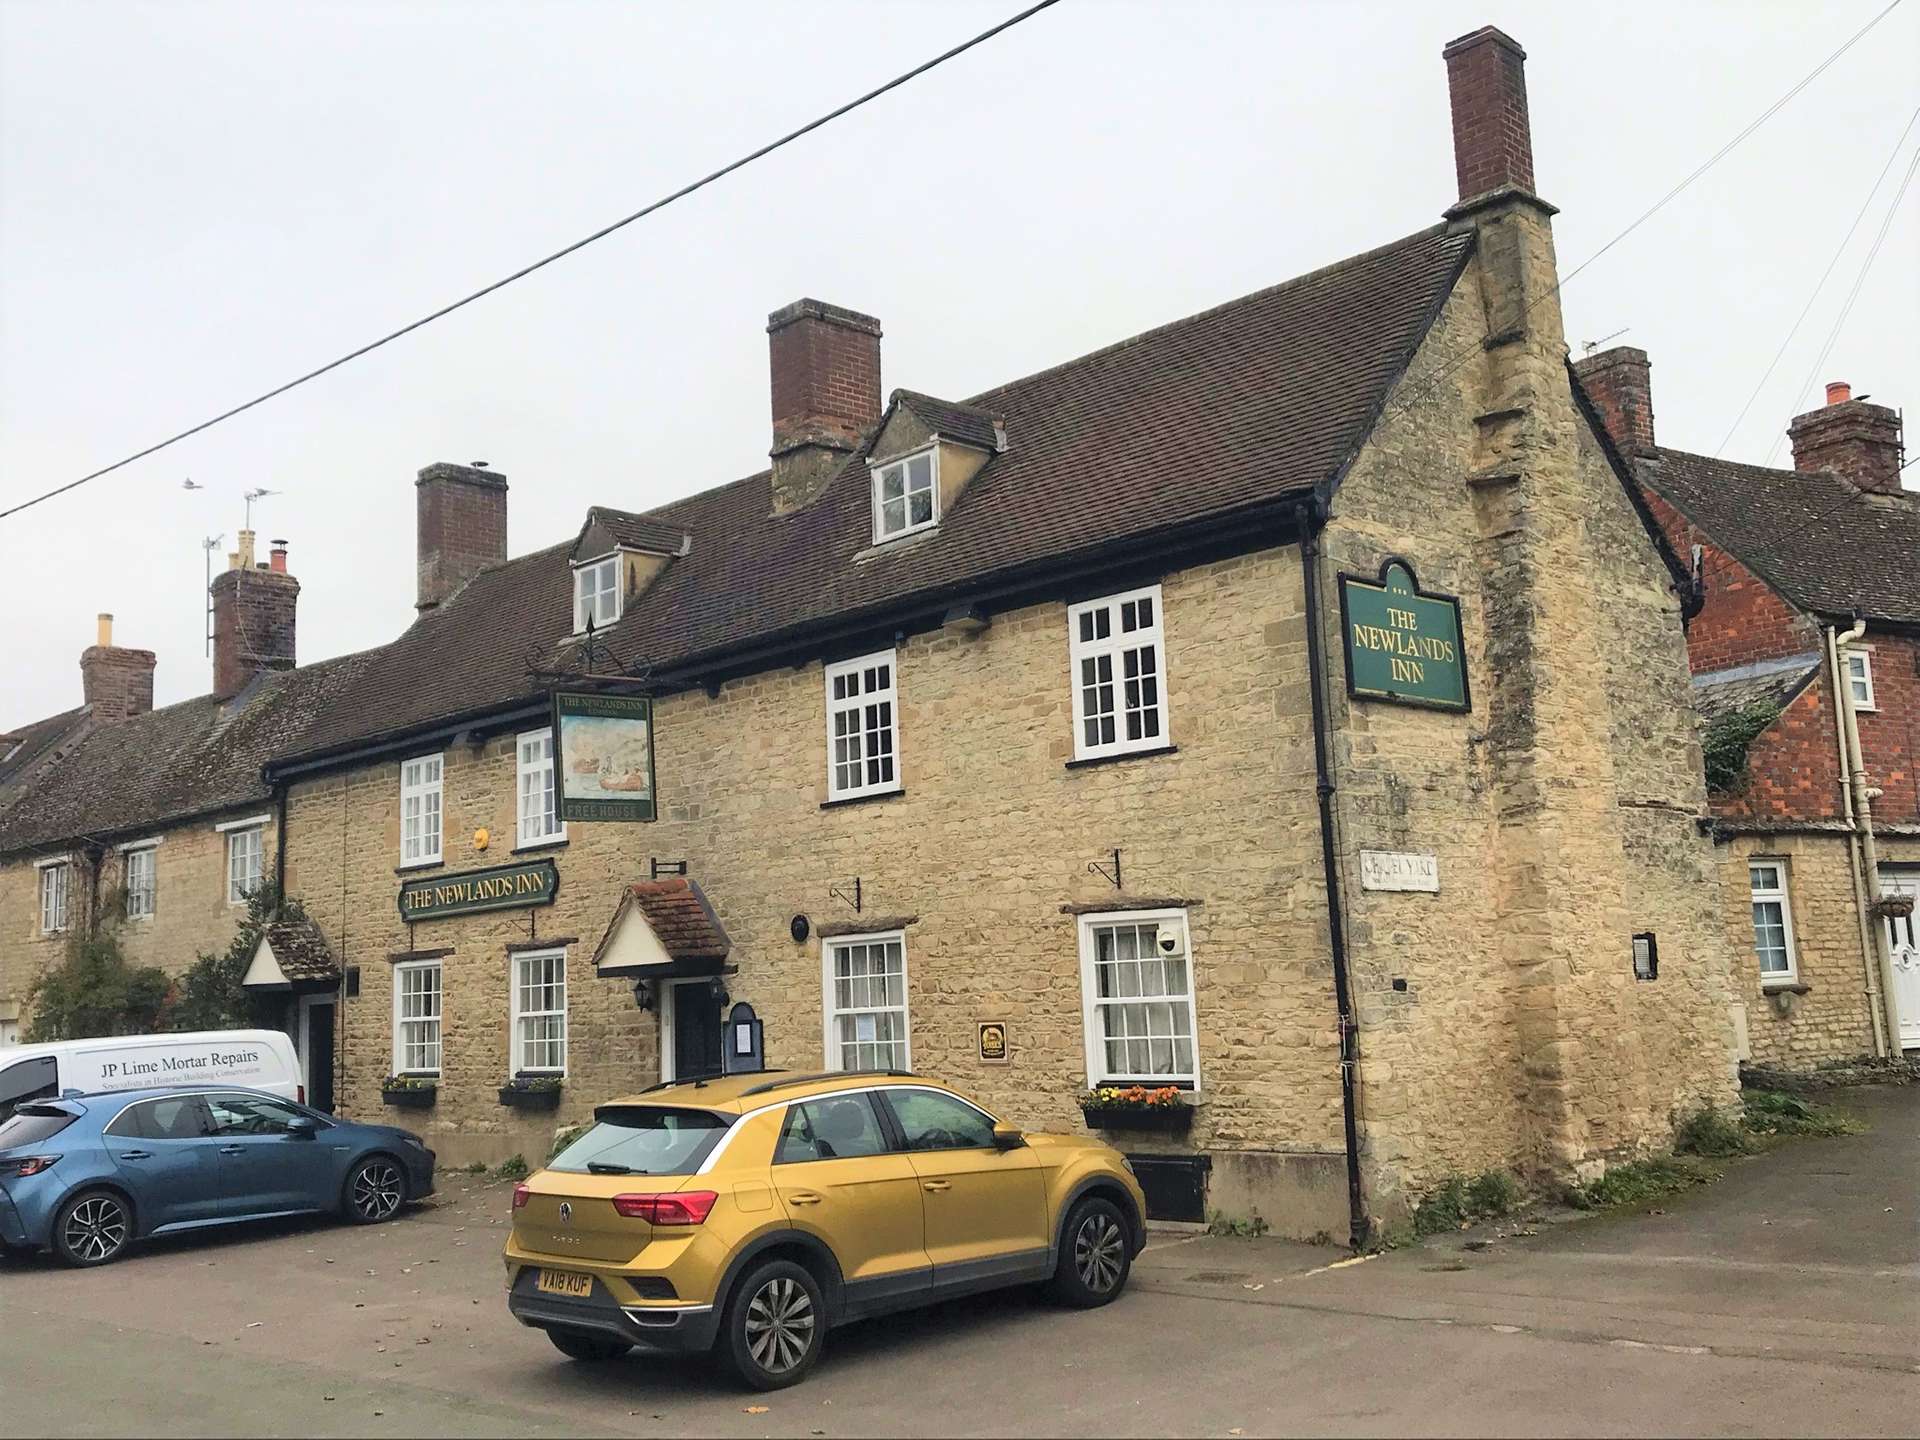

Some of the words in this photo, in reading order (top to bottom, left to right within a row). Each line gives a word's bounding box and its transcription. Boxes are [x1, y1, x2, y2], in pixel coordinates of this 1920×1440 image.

[1387, 608, 1417, 631] THE
[1353, 623, 1454, 663] NEWLANDS
[1390, 658, 1424, 684] INN
[567, 804, 598, 817] FREE
[600, 804, 638, 818] HOUSE
[406, 888, 432, 909] THE
[435, 876, 513, 906] NEWLANDS
[516, 871, 544, 894] INN
[101, 1063, 117, 1078] JP
[122, 1060, 158, 1075] Lime
[162, 1056, 207, 1072] Mortar
[211, 1050, 258, 1068] Repairs
[543, 1270, 565, 1290] VA18
[566, 1273, 589, 1295] KUF
